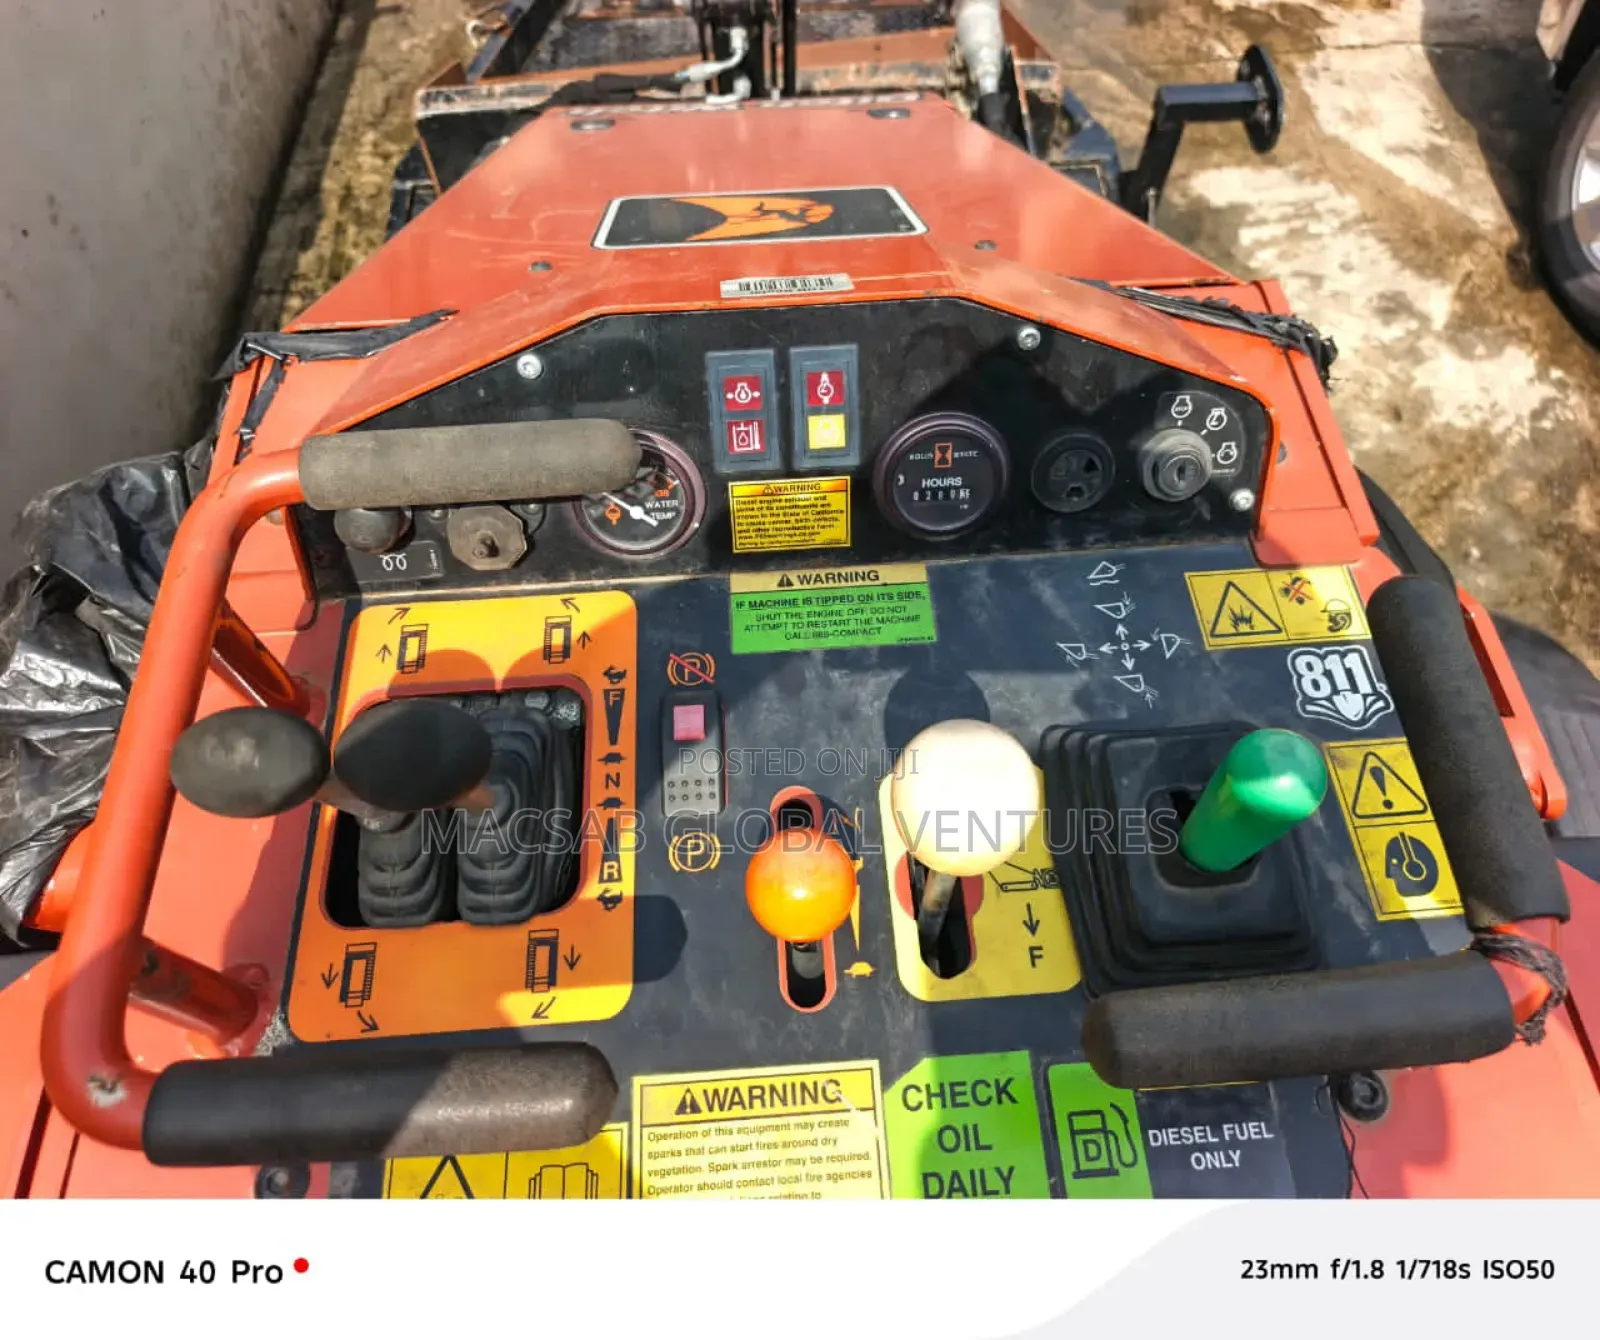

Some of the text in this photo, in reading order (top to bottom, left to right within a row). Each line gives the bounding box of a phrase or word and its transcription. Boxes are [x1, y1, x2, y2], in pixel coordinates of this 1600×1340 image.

[774, 484, 821, 493] WARNING
[921, 476, 963, 488] HOURS
[644, 499, 679, 509] WATER
[796, 569, 880, 586] WARNING
[736, 600, 745, 610] IF
[748, 598, 799, 609] MACHINE
[802, 596, 813, 606] IS
[814, 594, 855, 605] TIPPED
[857, 593, 874, 604] ON
[876, 591, 895, 602] ITS
[744, 614, 921, 632] ATTEMPT TO RESTART THE MACHINE
[755, 611, 782, 622] SHUT
[784, 610, 805, 621] THE
[806, 608, 844, 620] ENGINE
[870, 605, 884, 615] DO
[886, 605, 907, 615] NOT
[1294, 651, 1374, 698] 811
[608, 690, 621, 707] F
[605, 771, 621, 790] N
[602, 860, 620, 881] R
[1028, 945, 1044, 969] F
[702, 1079, 843, 1113] WARNING
[902, 1077, 1019, 1112] CHECK
[647, 1118, 850, 1144] Operation of this equipment may create
[936, 1123, 993, 1155] OIL
[1148, 1121, 1275, 1147] DIESEL FUEL
[647, 1136, 838, 1160] sparks that can start fires around dry
[647, 1150, 872, 1179] vegetation. Spark arrestor may be required.
[1189, 1149, 1242, 1171] ONLY
[647, 1169, 873, 1197] Operator should contact local fire agencies
[921, 1165, 1016, 1200] DAILY
[811, 1190, 822, 1199] to
